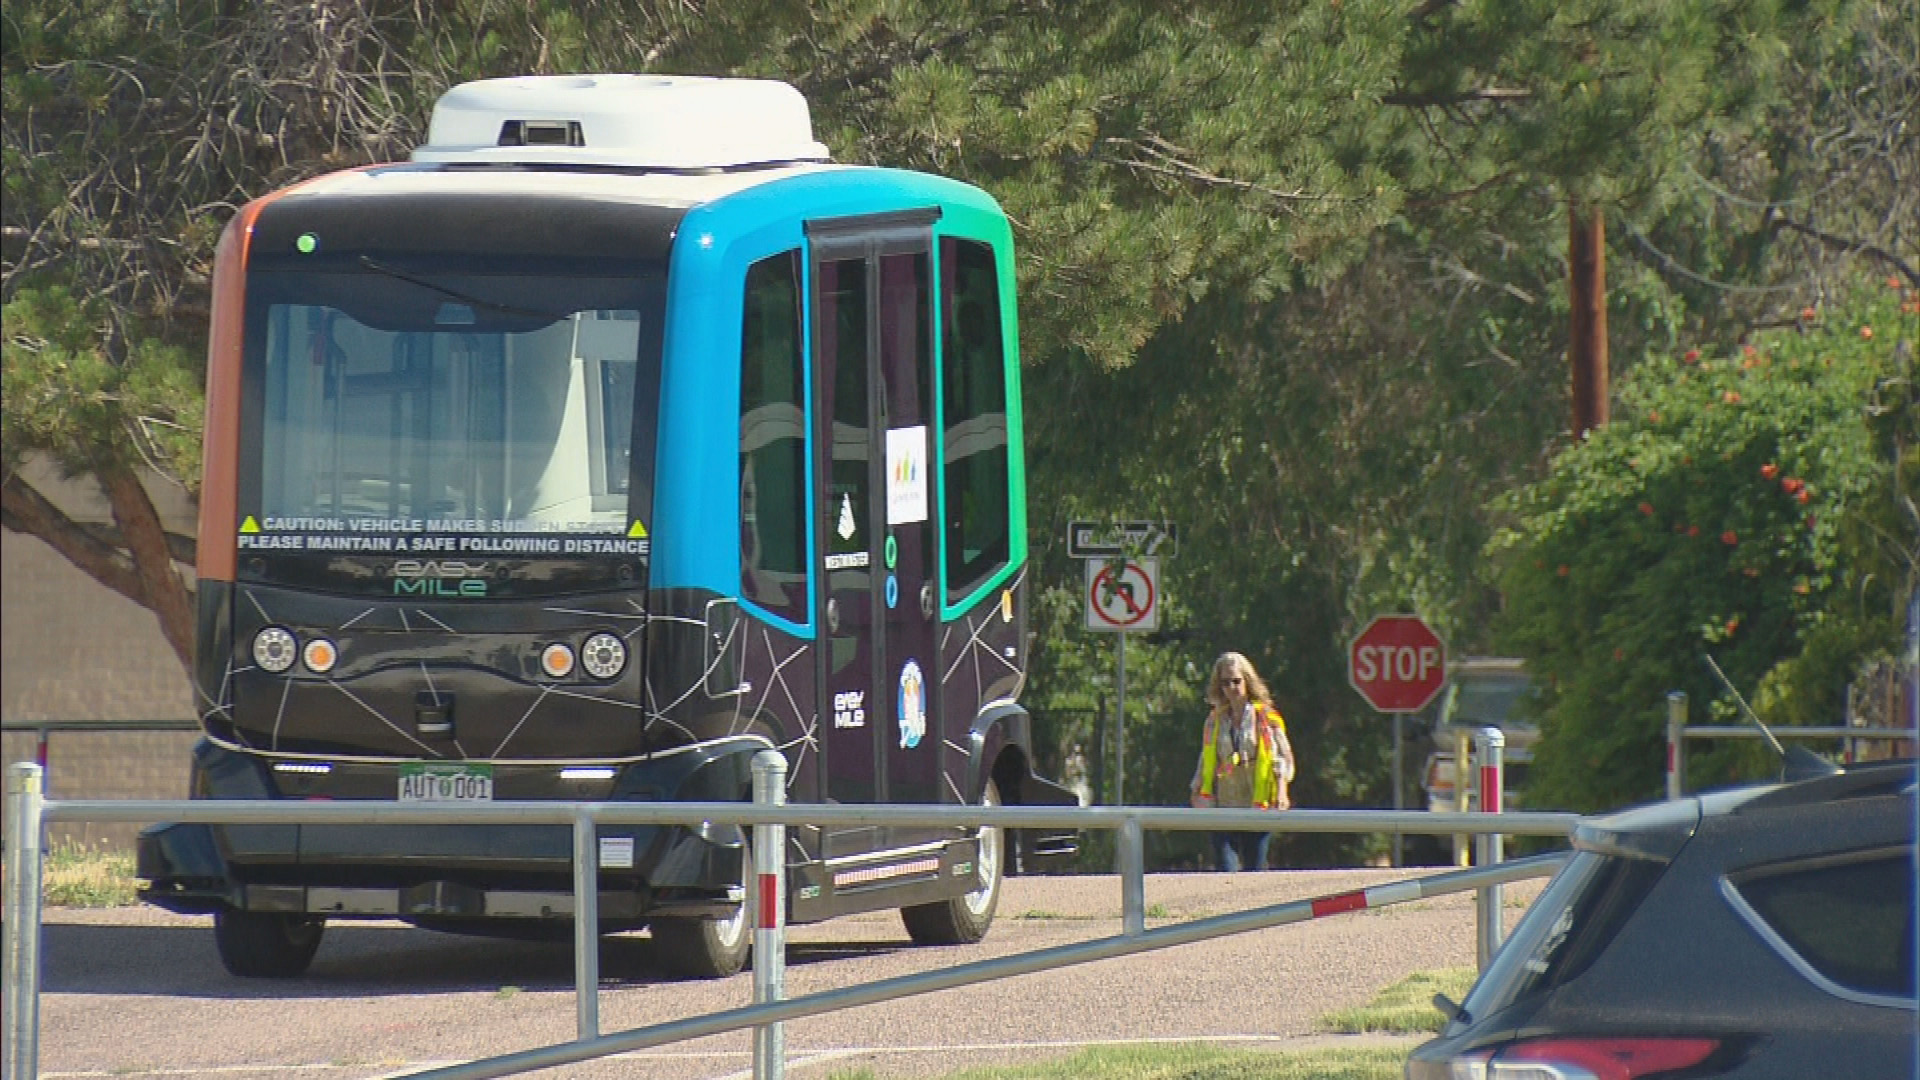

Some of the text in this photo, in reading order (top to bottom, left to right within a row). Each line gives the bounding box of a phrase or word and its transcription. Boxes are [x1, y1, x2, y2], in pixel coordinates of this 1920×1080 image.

[263, 517, 344, 531] CAUTION:
[349, 518, 423, 532] VEHICLE
[426, 519, 485, 533] MAKES
[237, 535, 650, 553] PLEASE MAINTAIN A SAFE FOLLOWING DISTANCE
[1357, 645, 1440, 682] STOP
